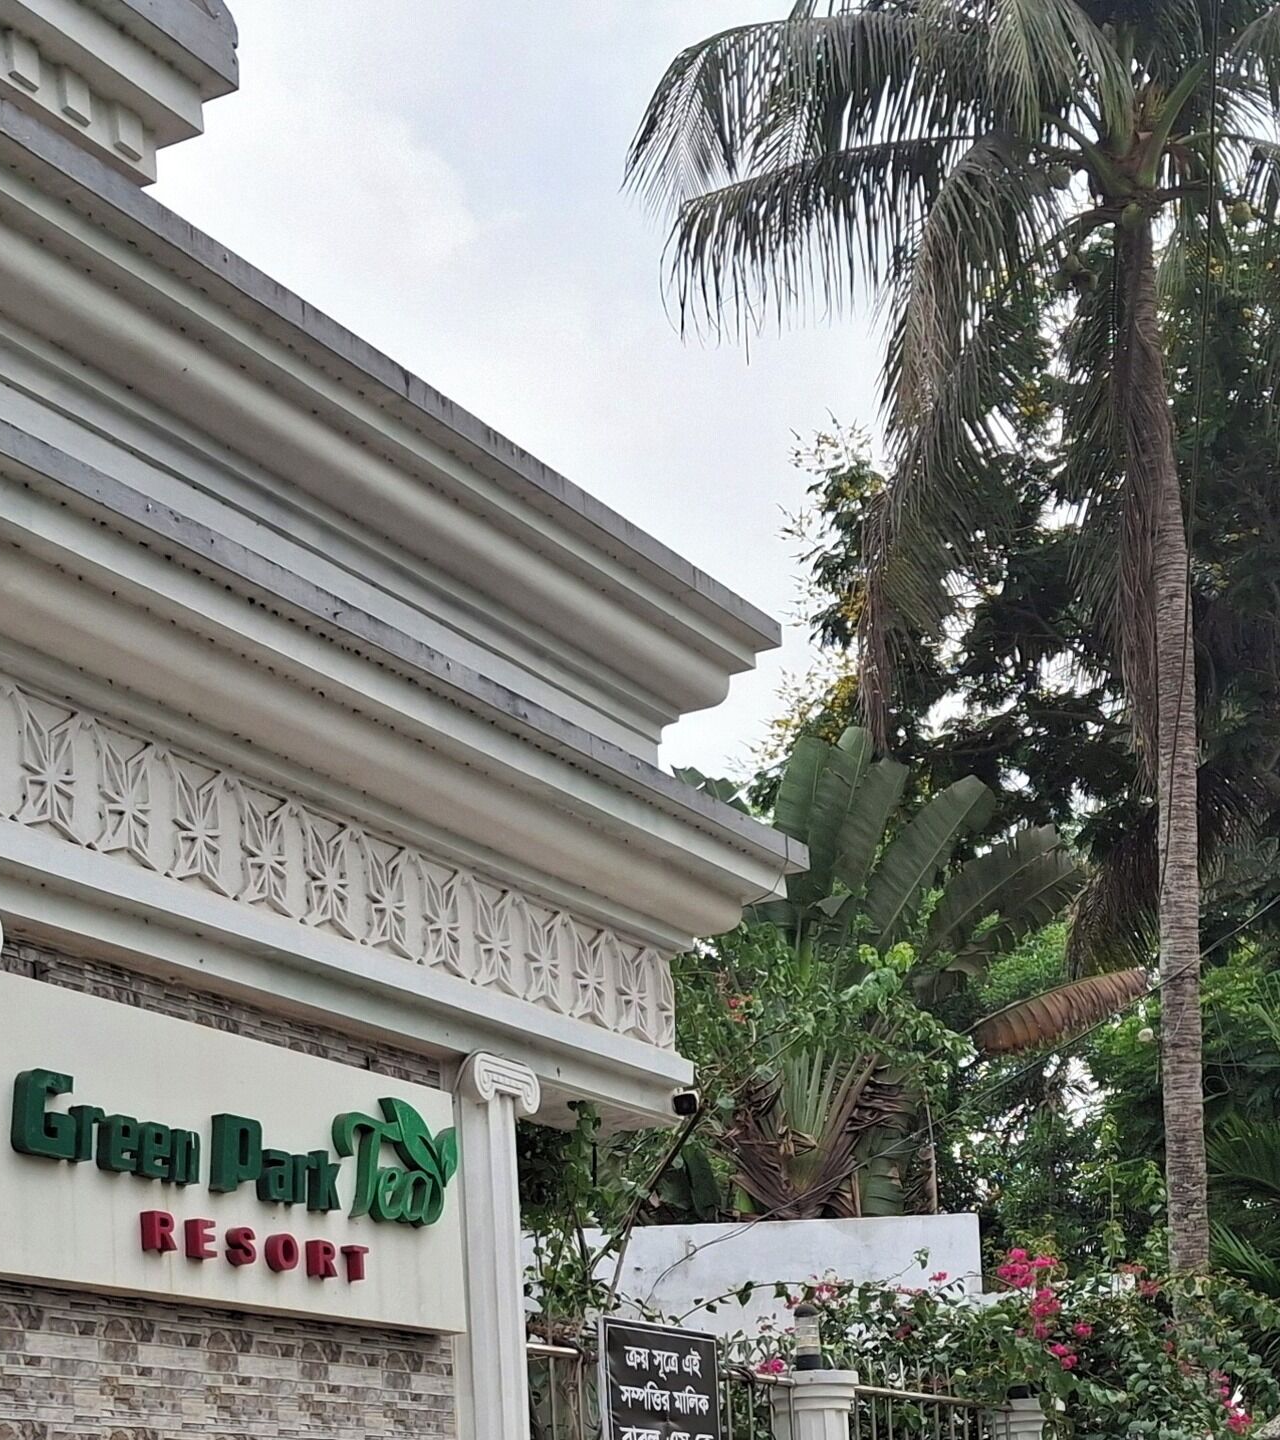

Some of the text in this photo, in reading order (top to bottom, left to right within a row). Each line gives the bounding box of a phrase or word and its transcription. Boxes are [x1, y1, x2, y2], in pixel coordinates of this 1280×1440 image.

[11, 1068, 447, 1228] Green Park Tea
[140, 1210, 370, 1283] RESORT
[624, 1345, 702, 1381] ক্রয় সূত্রে এই
[619, 1381, 710, 1416] সম্পত্তির মালিক
